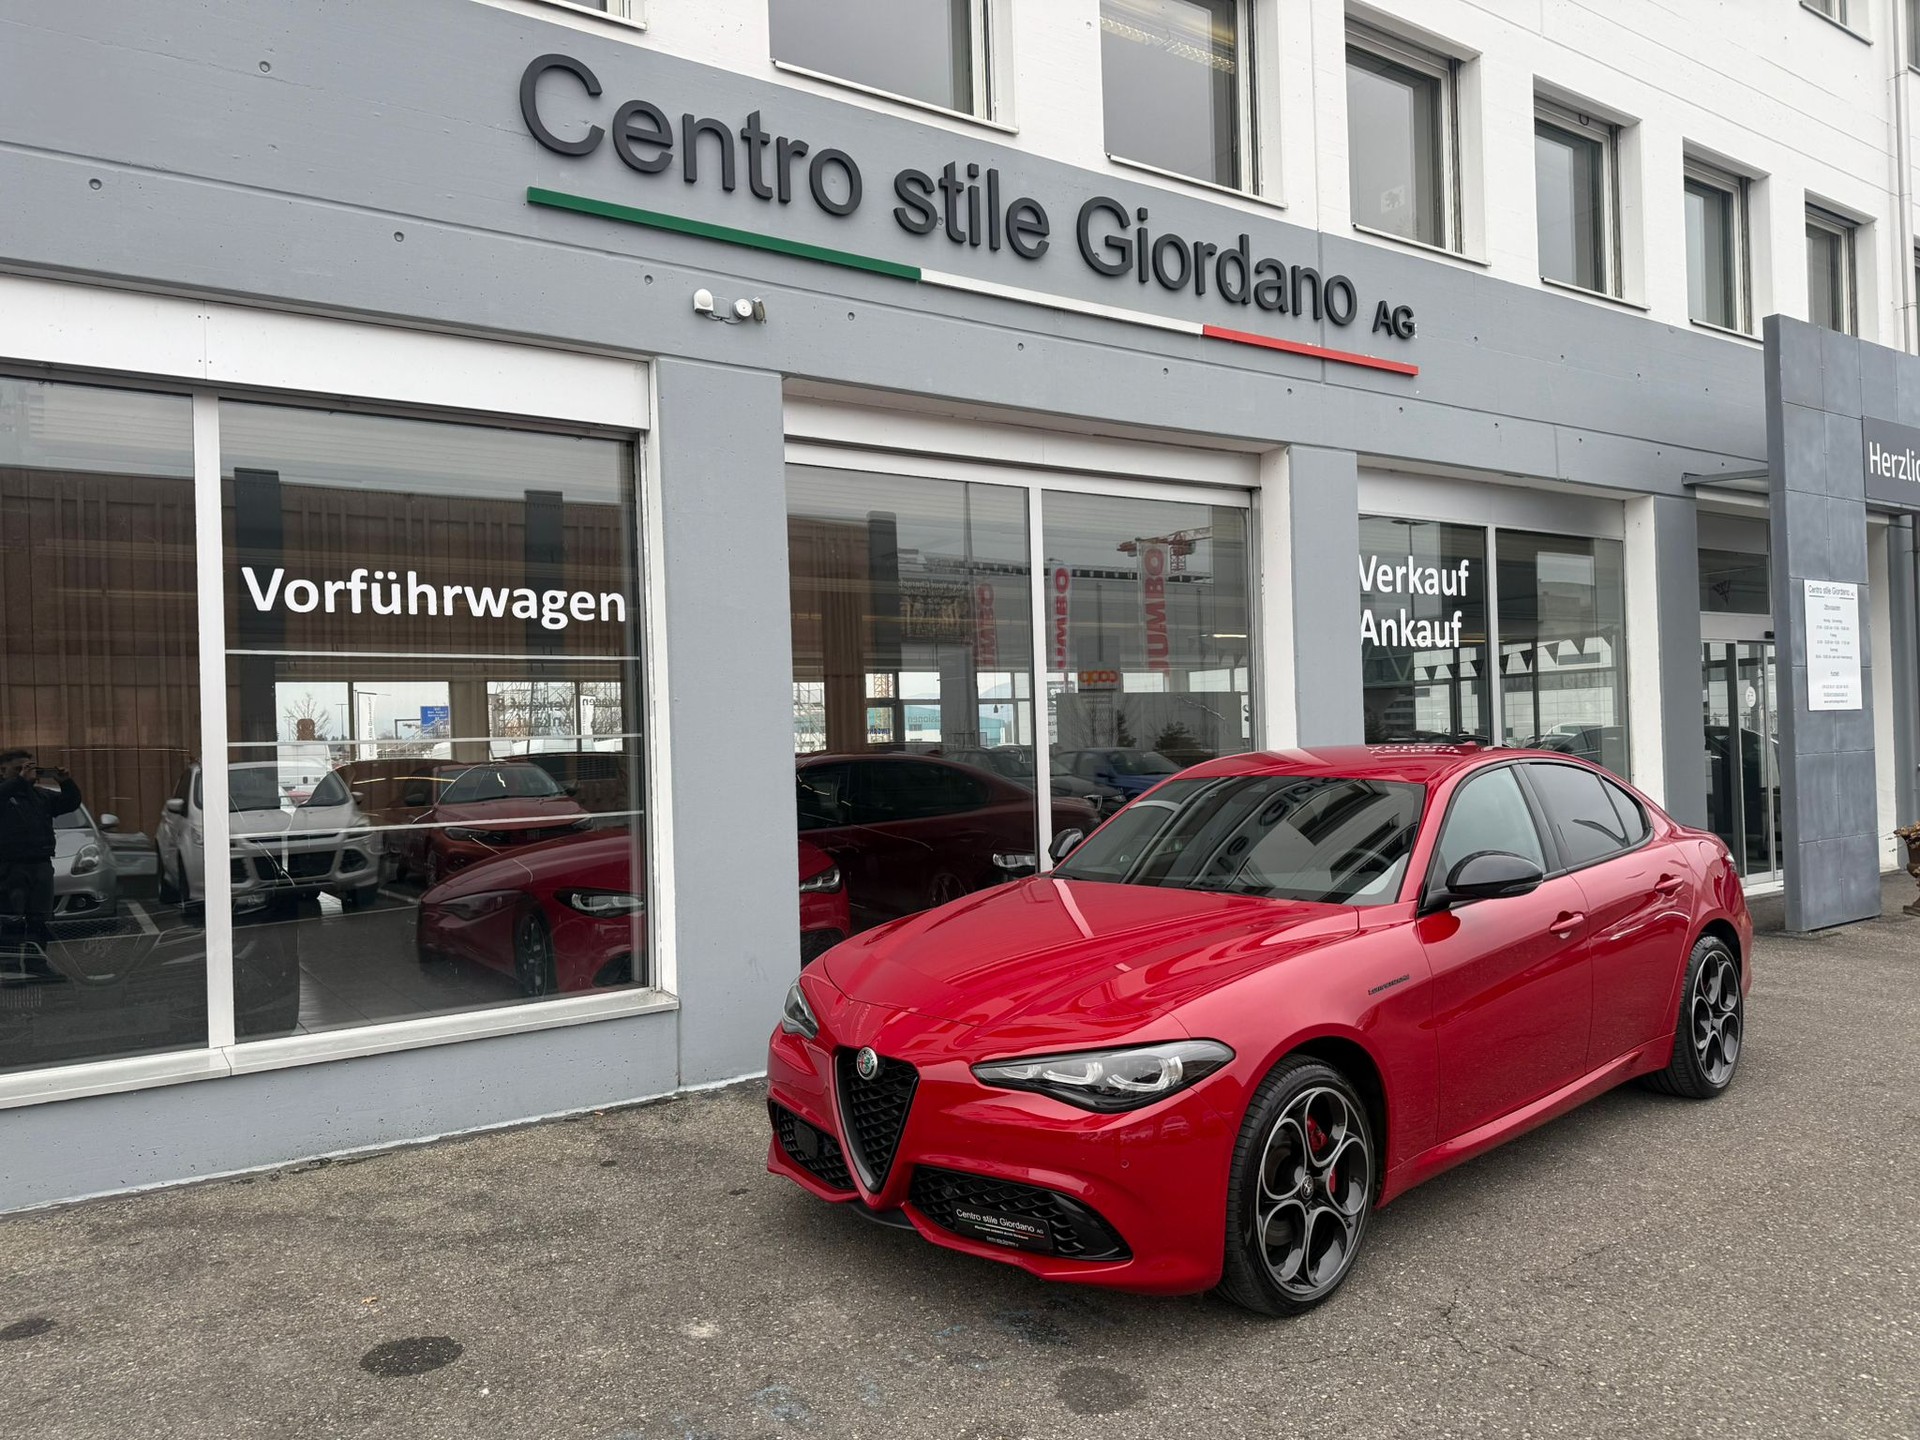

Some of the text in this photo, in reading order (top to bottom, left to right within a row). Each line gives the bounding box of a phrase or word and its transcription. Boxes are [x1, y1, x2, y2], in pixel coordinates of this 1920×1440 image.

[519, 52, 1417, 339] Centro stile Giordano AG
[241, 566, 626, 630] Vorführwagen
[1358, 554, 1469, 597] Verkauf
[1144, 548, 1170, 677] JUMBO
[1360, 608, 1463, 649] Ankauf
[956, 1208, 981, 1221] Centro
[999, 1217, 1035, 1233] Giordano
